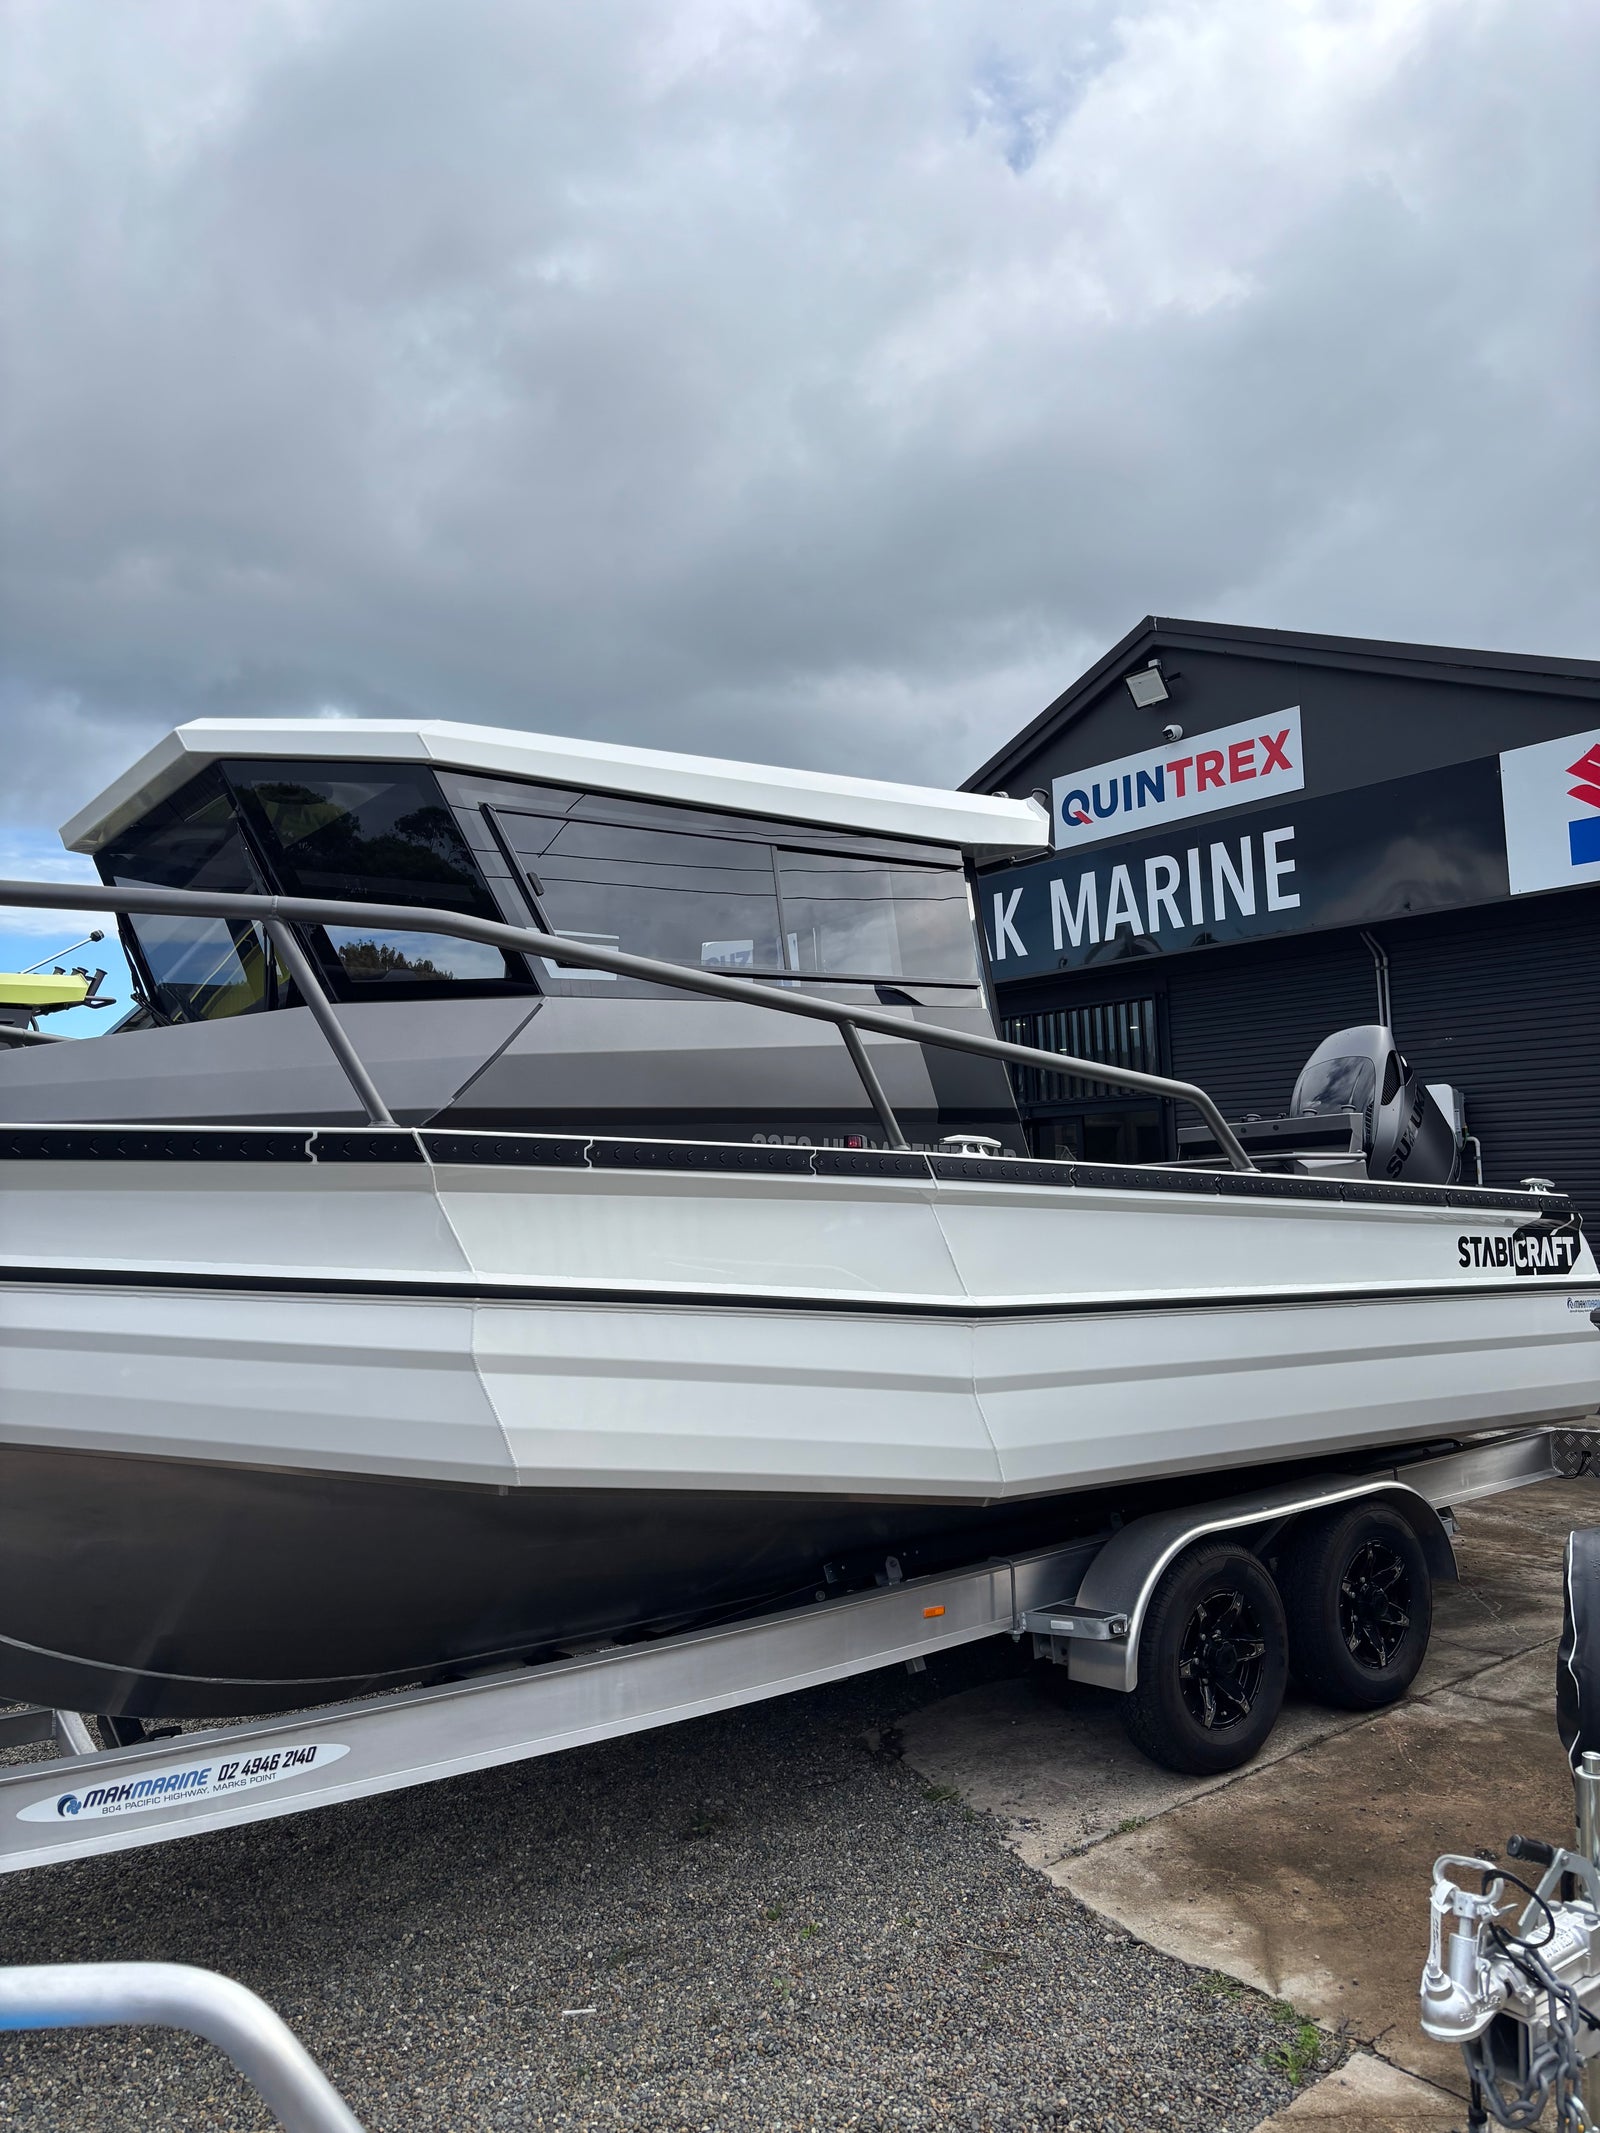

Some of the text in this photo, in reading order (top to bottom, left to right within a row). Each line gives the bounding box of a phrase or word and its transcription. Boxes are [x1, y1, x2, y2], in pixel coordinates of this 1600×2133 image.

[1061, 729, 1293, 826] QUINTREX
[984, 825, 1300, 962] K MARINE
[1458, 1236, 1574, 1268] STABICRAFT
[83, 1746, 317, 1808] MAKMARINE 02 4946 2140
[102, 1805, 122, 1815] 804
[124, 1797, 161, 1810] PACIFIC
[213, 1779, 247, 1792] MARKS
[250, 1773, 277, 1785] POINT
